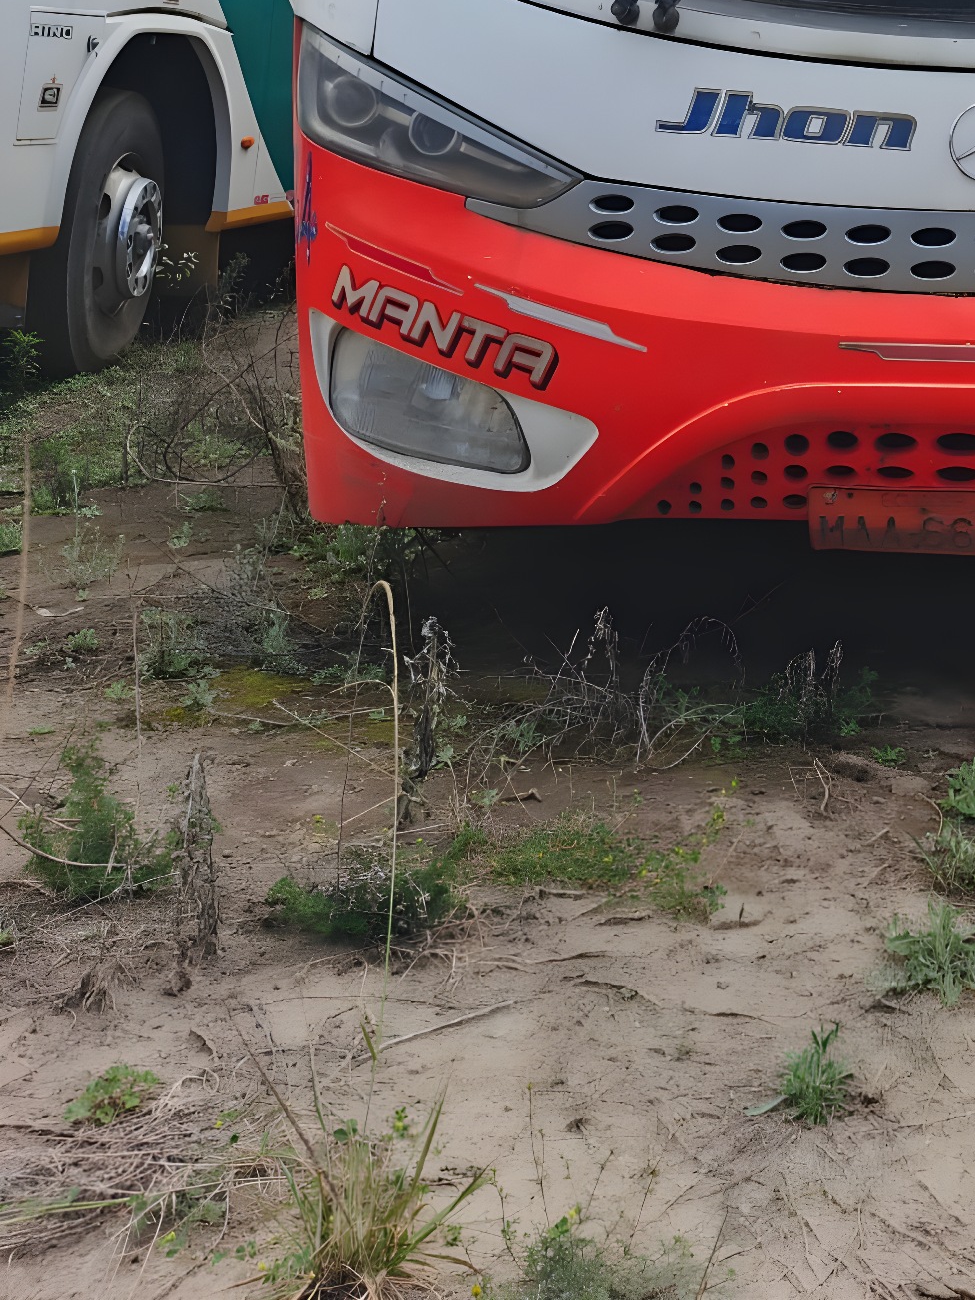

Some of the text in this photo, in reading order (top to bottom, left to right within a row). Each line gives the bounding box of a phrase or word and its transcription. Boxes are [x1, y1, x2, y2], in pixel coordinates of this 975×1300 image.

[30, 23, 73, 40] HINO
[655, 87, 918, 152] Jhon
[331, 263, 560, 391] MANTA
